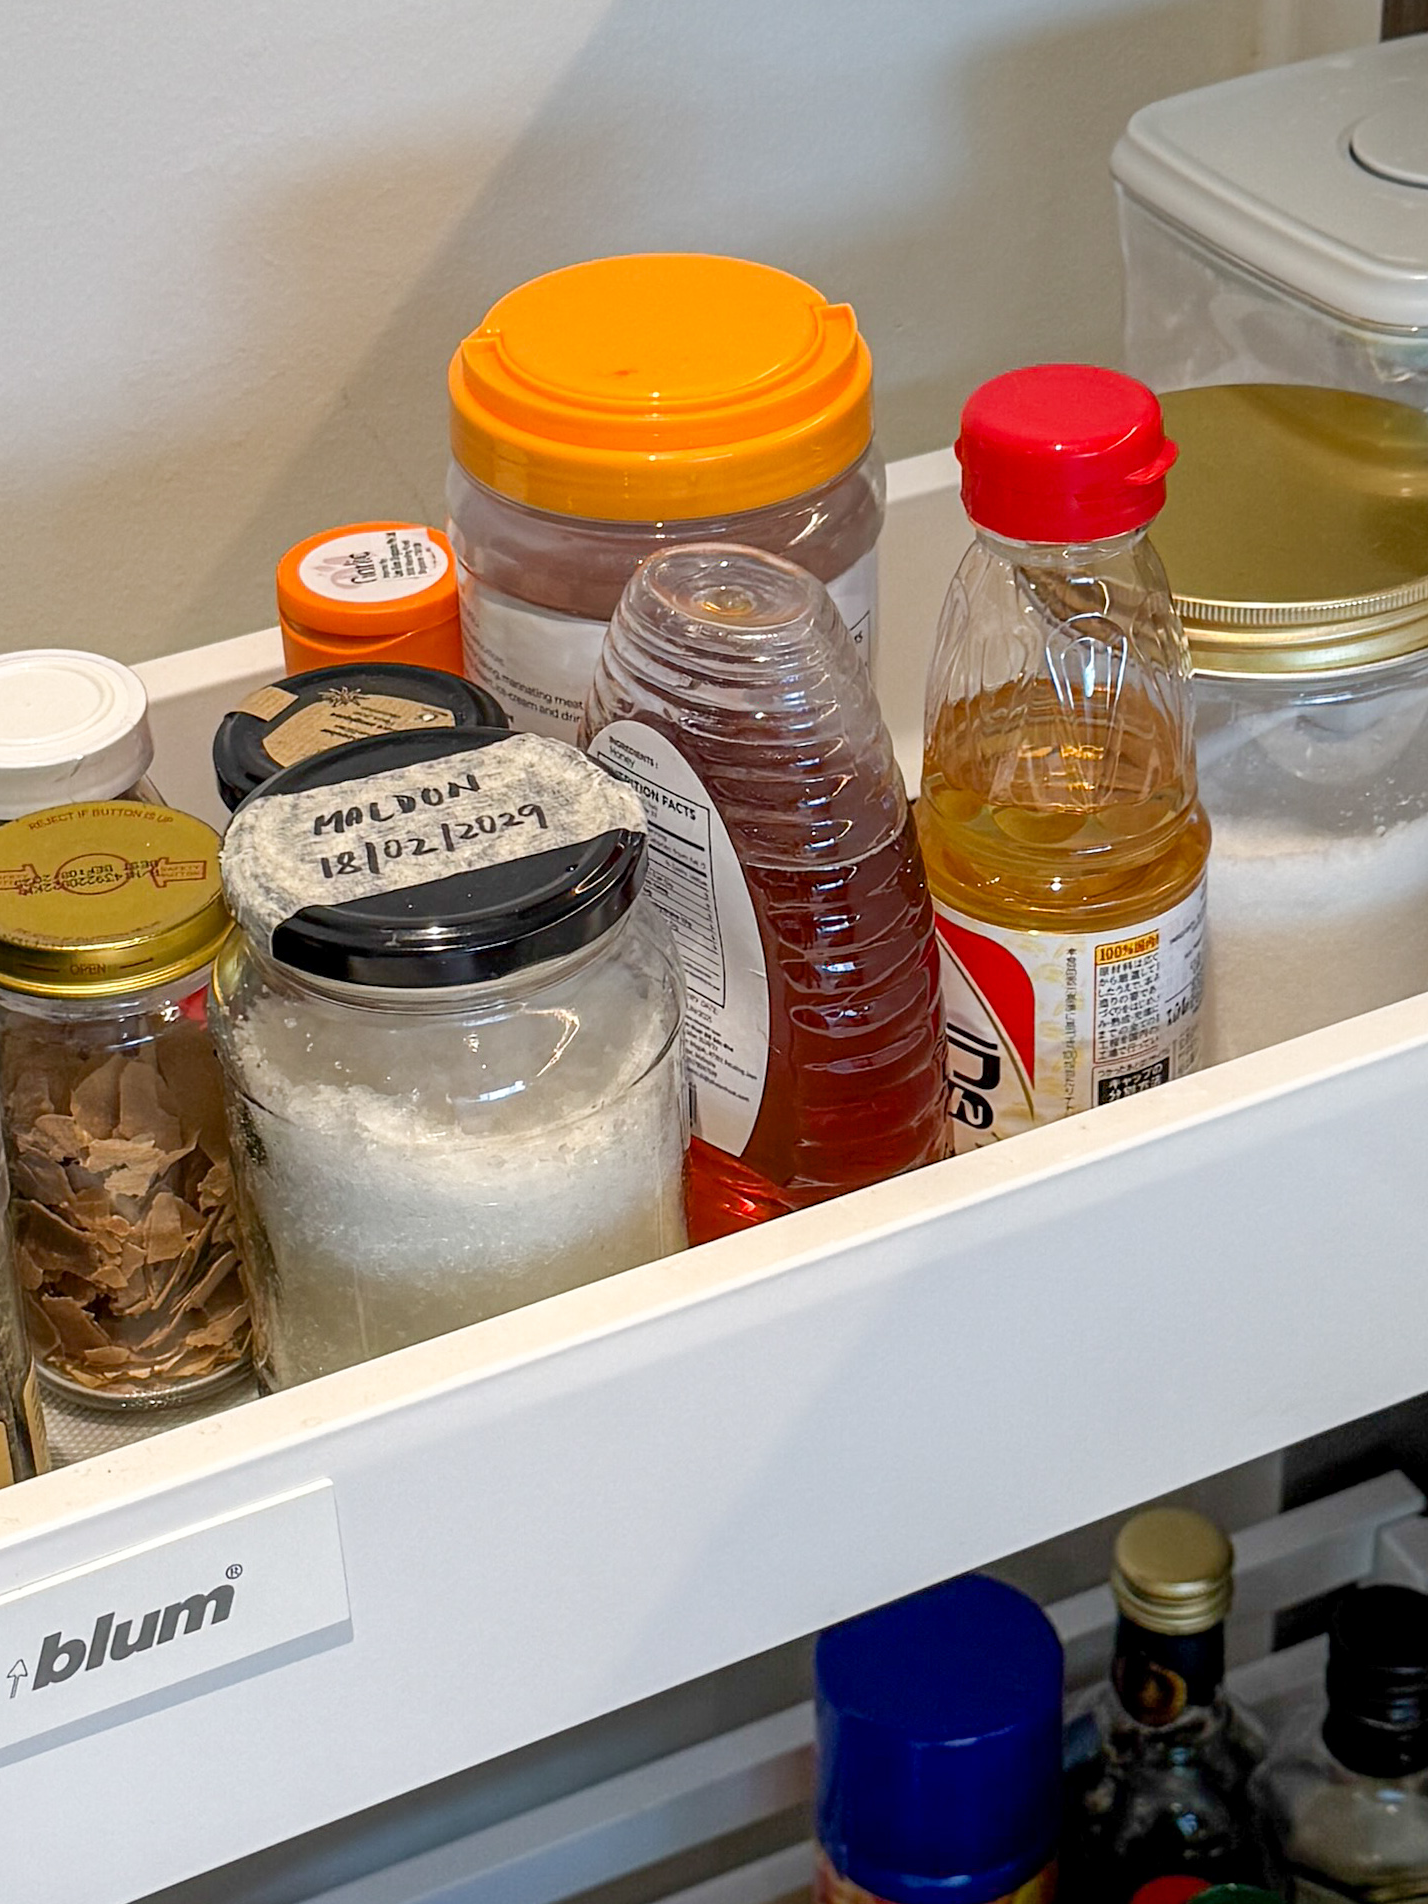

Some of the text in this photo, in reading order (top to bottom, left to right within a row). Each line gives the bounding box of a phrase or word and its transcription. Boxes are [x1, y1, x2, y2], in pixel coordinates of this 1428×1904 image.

[28, 807, 174, 831] REJECT IF BUTTON IS UP
[313, 773, 481, 836] MALDON
[661, 795, 697, 821] FACTS
[321, 803, 549, 879] 18/02/2029
[69, 962, 106, 976] OPEN
[31, 1584, 236, 1692] blum
